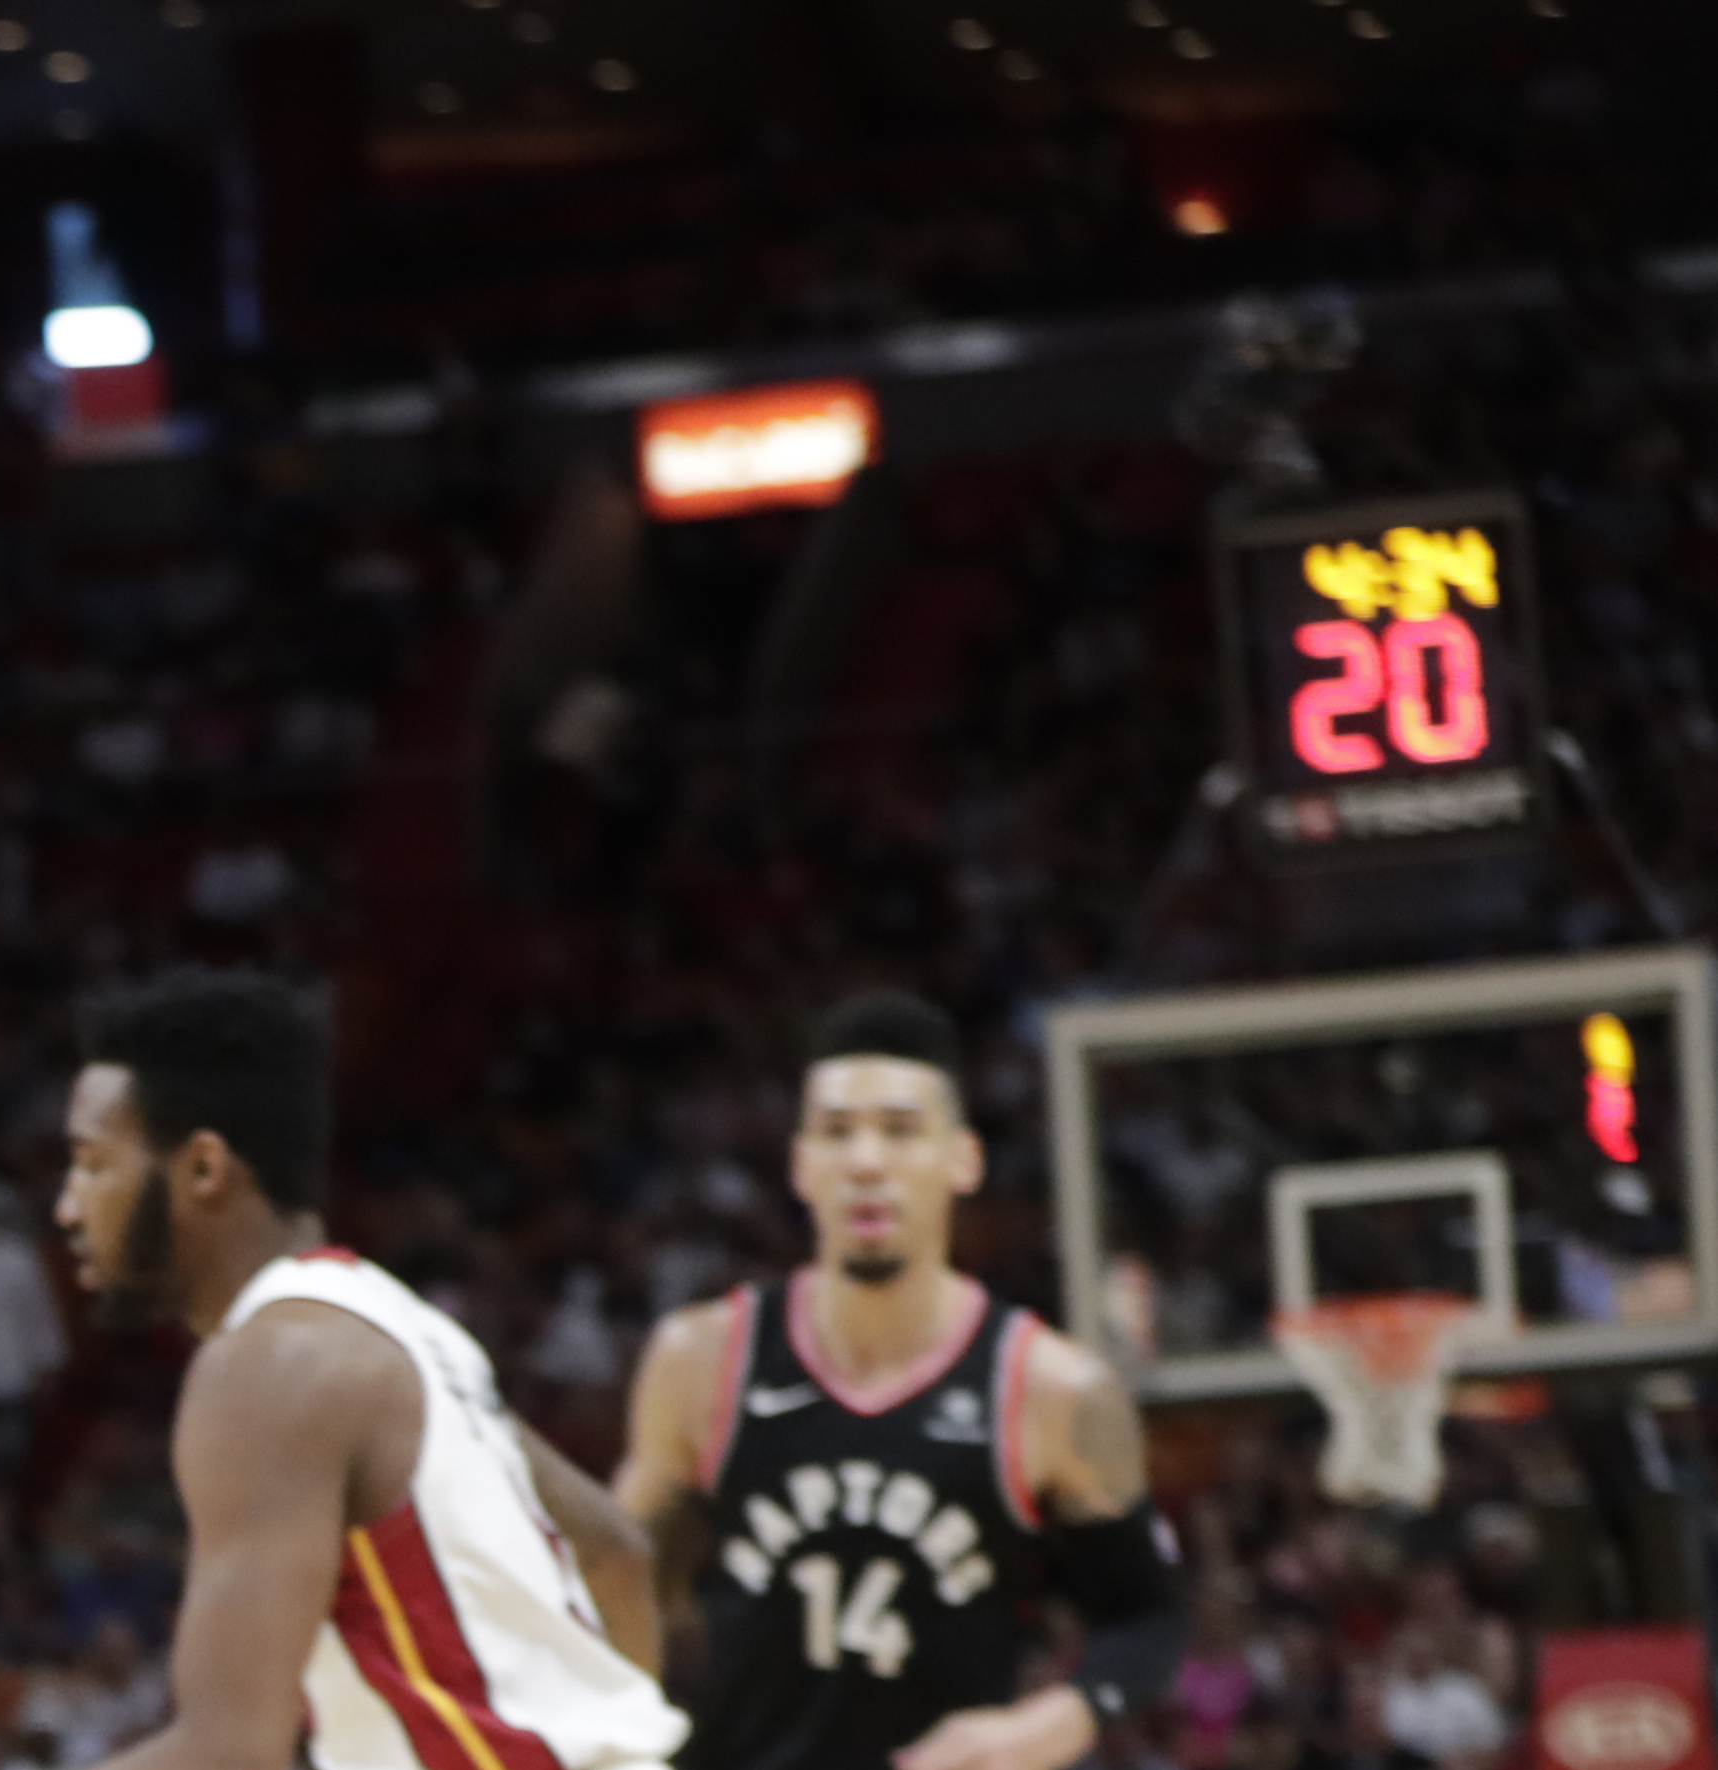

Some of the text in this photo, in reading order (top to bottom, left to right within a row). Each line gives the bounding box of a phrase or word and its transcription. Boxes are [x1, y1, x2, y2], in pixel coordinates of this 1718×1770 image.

[1290, 612, 1490, 774] 20
[720, 1457, 995, 1606] RAPTORS
[787, 1552, 914, 1679] 14
